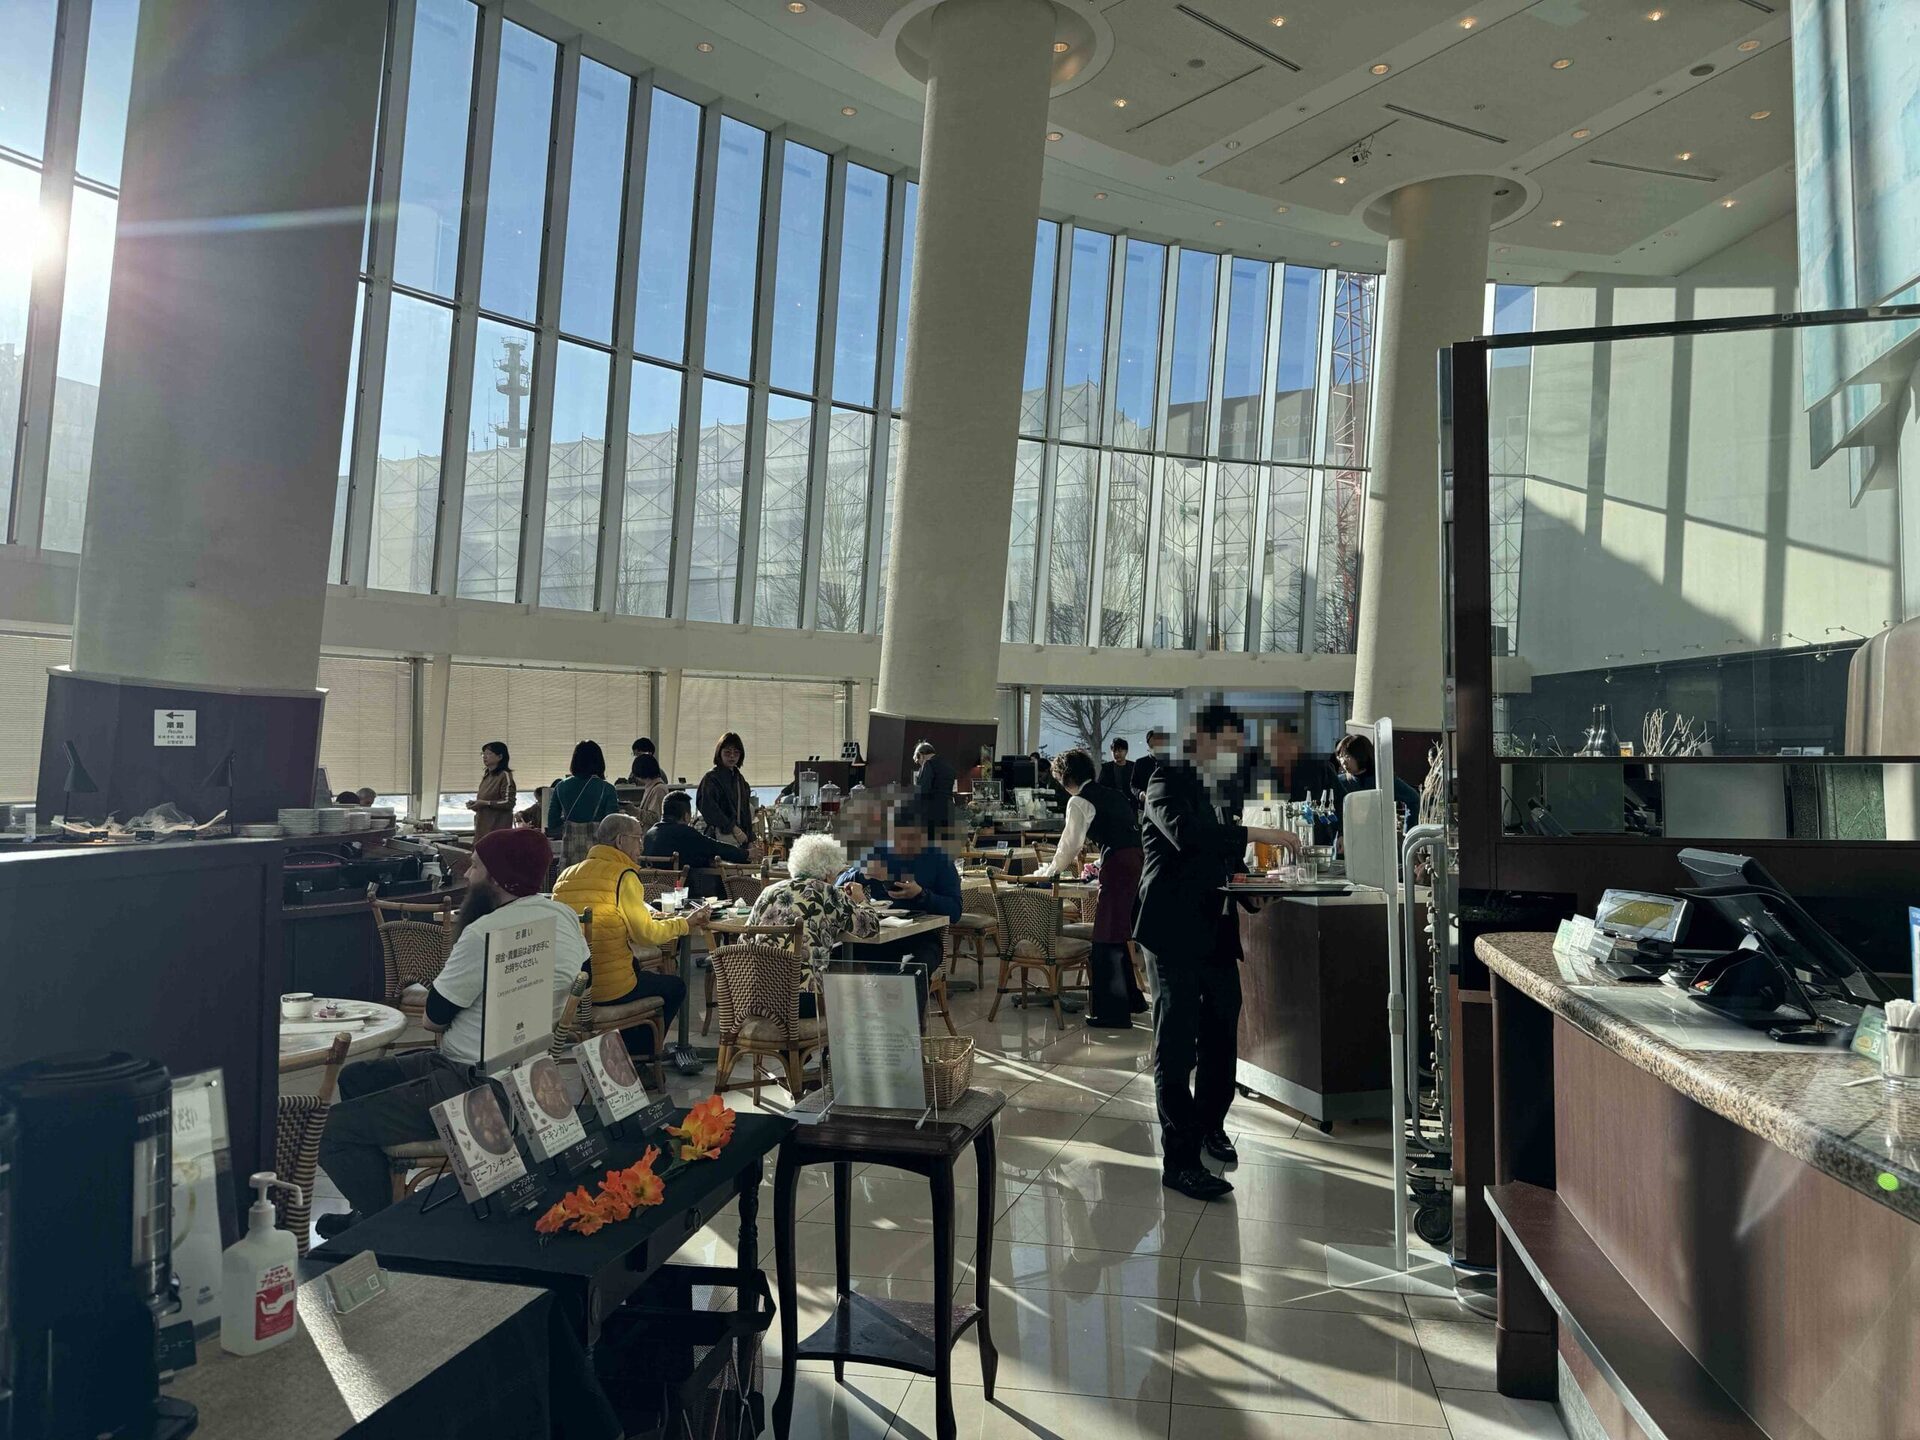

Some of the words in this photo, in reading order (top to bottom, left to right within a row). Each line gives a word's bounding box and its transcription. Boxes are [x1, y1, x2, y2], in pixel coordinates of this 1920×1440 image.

[515, 928, 533, 940] お願い
[608, 1090, 640, 1109] ビーフカレー
[541, 1121, 575, 1144] チキンカレー
[472, 1155, 517, 1182] ビーフシチュー
[260, 1272, 293, 1288] アルコール
